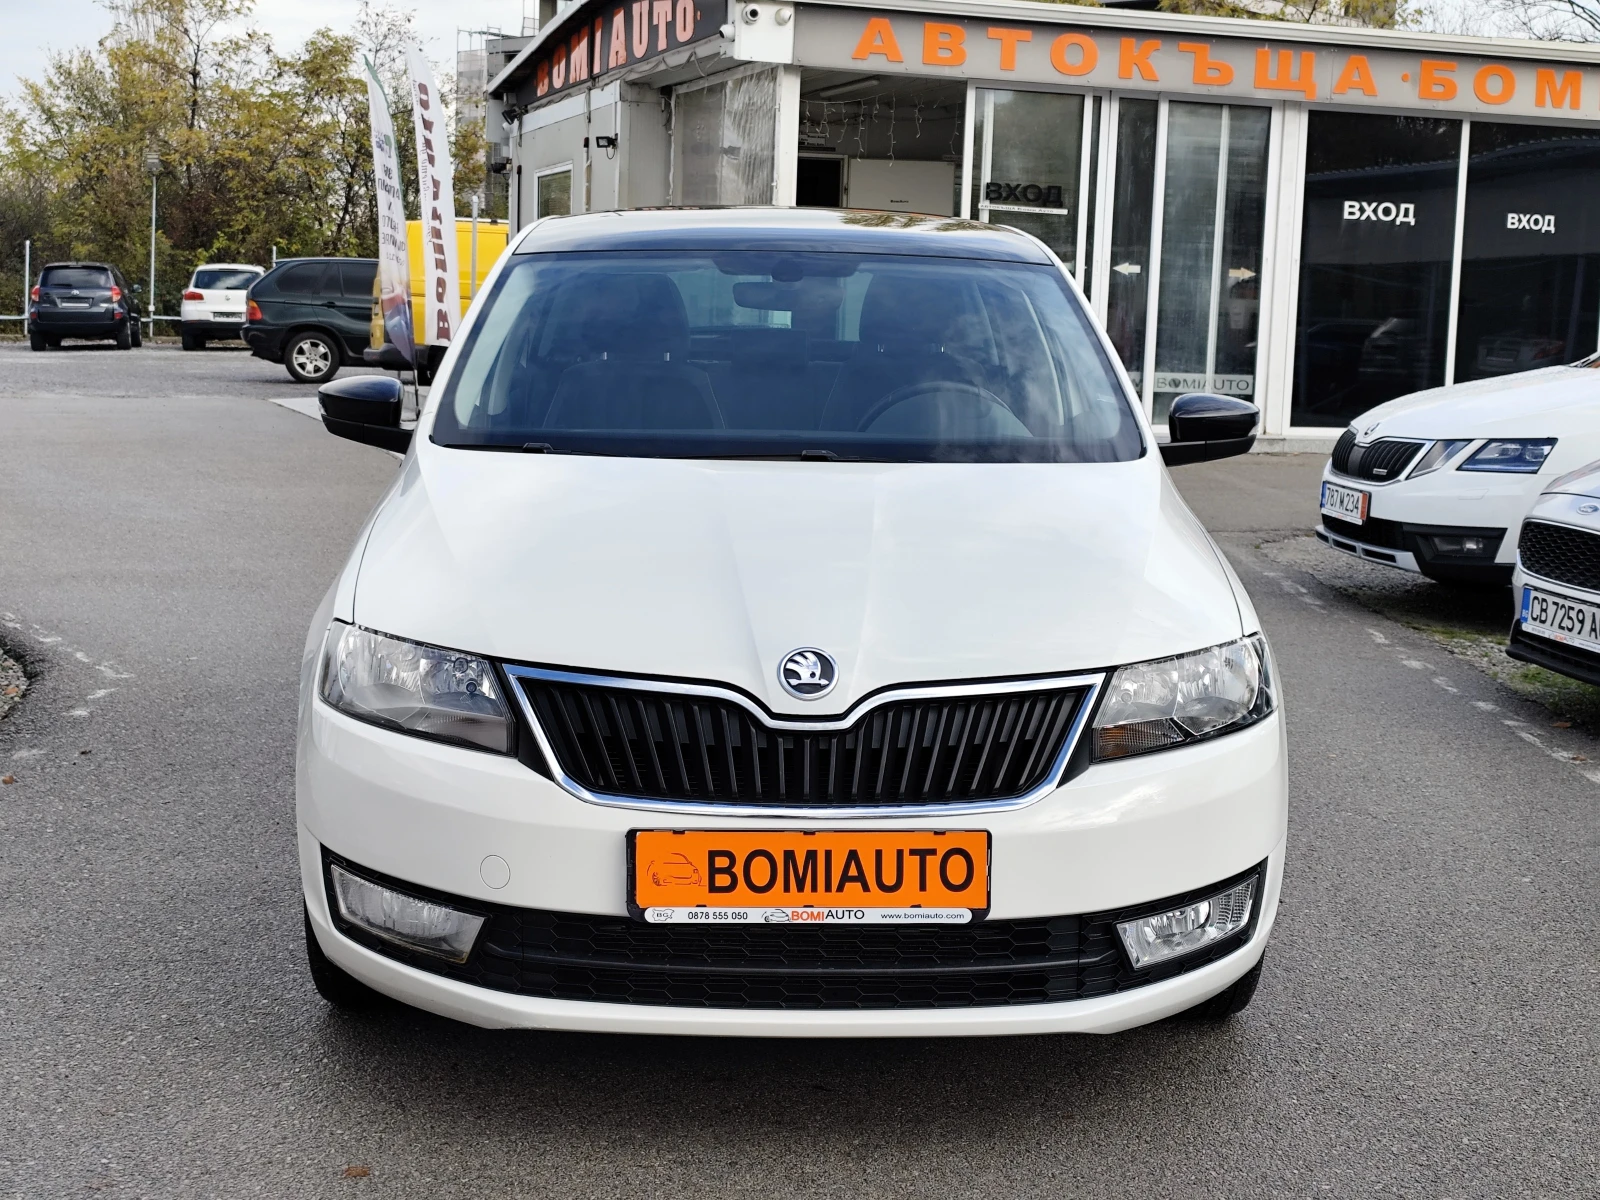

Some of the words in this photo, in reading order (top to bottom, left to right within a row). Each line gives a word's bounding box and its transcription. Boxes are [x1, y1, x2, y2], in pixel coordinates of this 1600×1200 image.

[537, 0, 695, 97] BOMIAUTO
[852, 17, 1378, 99] АВТОКЪЩА
[1418, 59, 1600, 110] БОМ
[986, 182, 1063, 208] ВХОД
[1343, 200, 1416, 226] ВХОД
[1506, 212, 1556, 234] ВХОД
[707, 847, 975, 894] BOMIAUTO
[687, 911, 710, 920] 0878
[712, 911, 729, 920] 555
[731, 911, 748, 920] 050
[791, 909, 865, 922] BOMIAUTO
[880, 911, 965, 920] www.bomiauto.com
